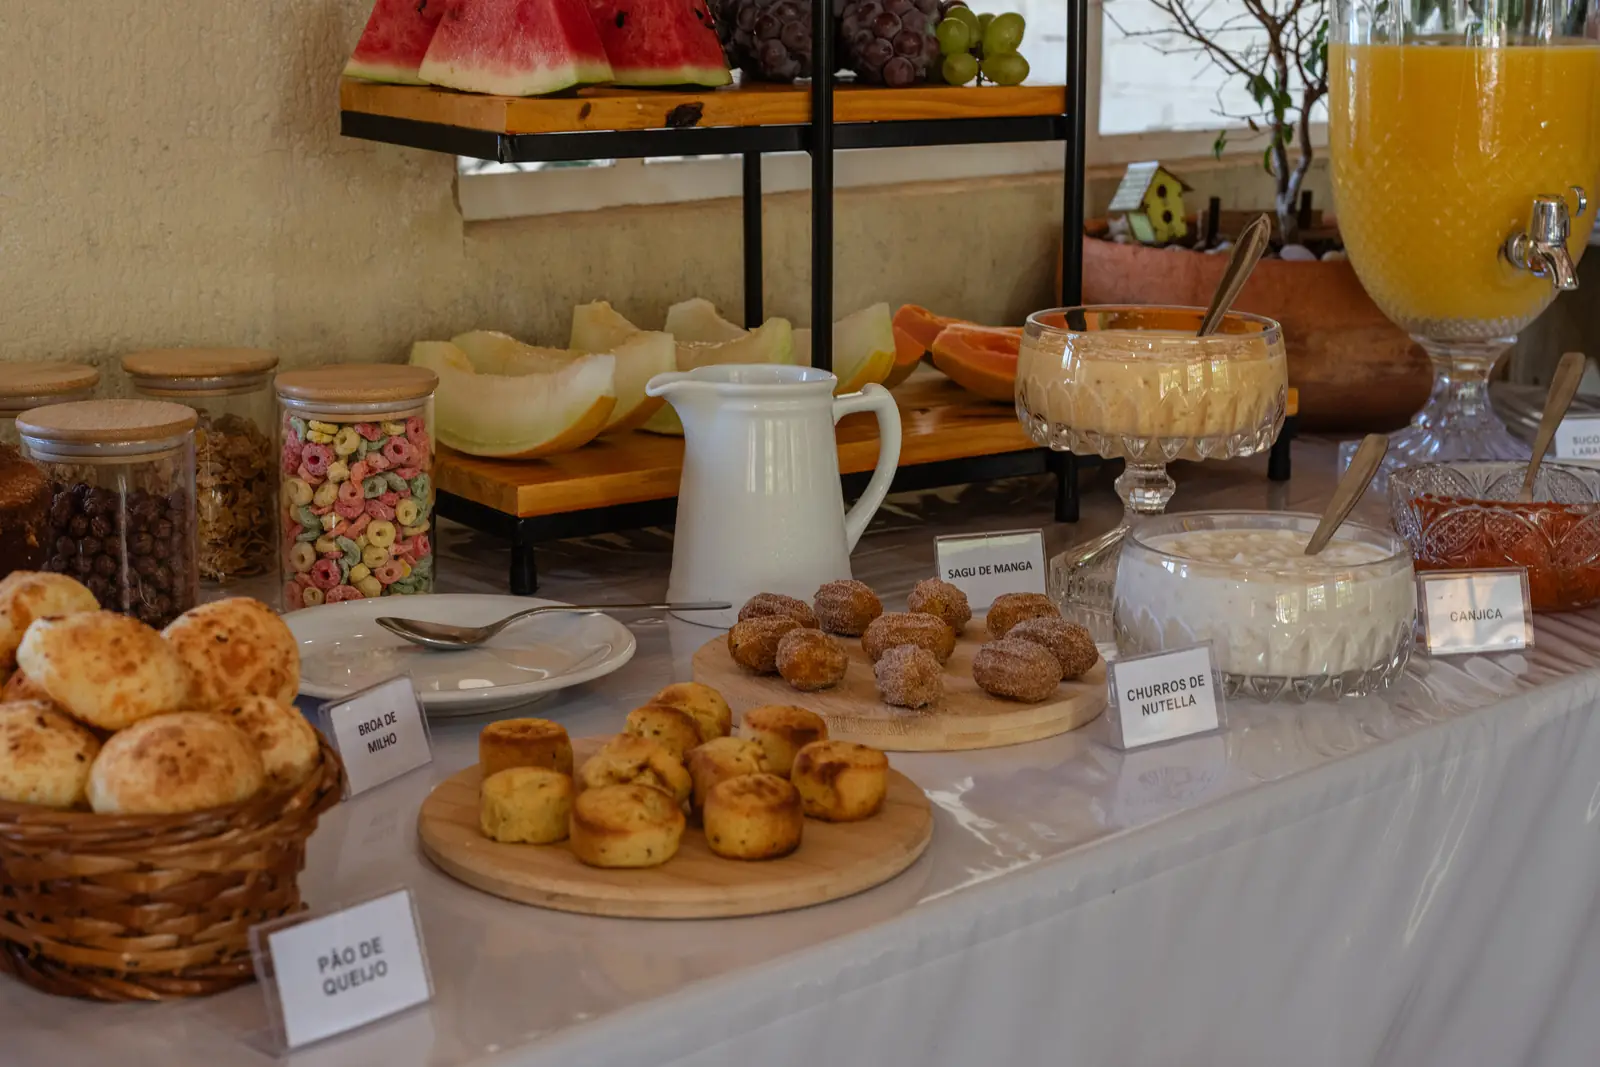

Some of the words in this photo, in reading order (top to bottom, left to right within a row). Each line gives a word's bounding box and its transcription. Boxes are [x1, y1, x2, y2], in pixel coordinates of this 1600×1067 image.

[948, 567, 976, 579] SAGU
[979, 565, 992, 576] DE
[994, 560, 1033, 574] MANGA
[1450, 608, 1503, 622] CANJICA
[1127, 678, 1187, 702] CHURROS
[1189, 674, 1205, 689] DE
[1141, 694, 1197, 716] NUTELLA
[358, 716, 384, 736] BROA
[384, 711, 397, 726] DE
[367, 732, 397, 754] MILHO
[317, 945, 356, 975] PÃO
[359, 936, 384, 959] DE
[322, 959, 388, 996] QUEIJO
